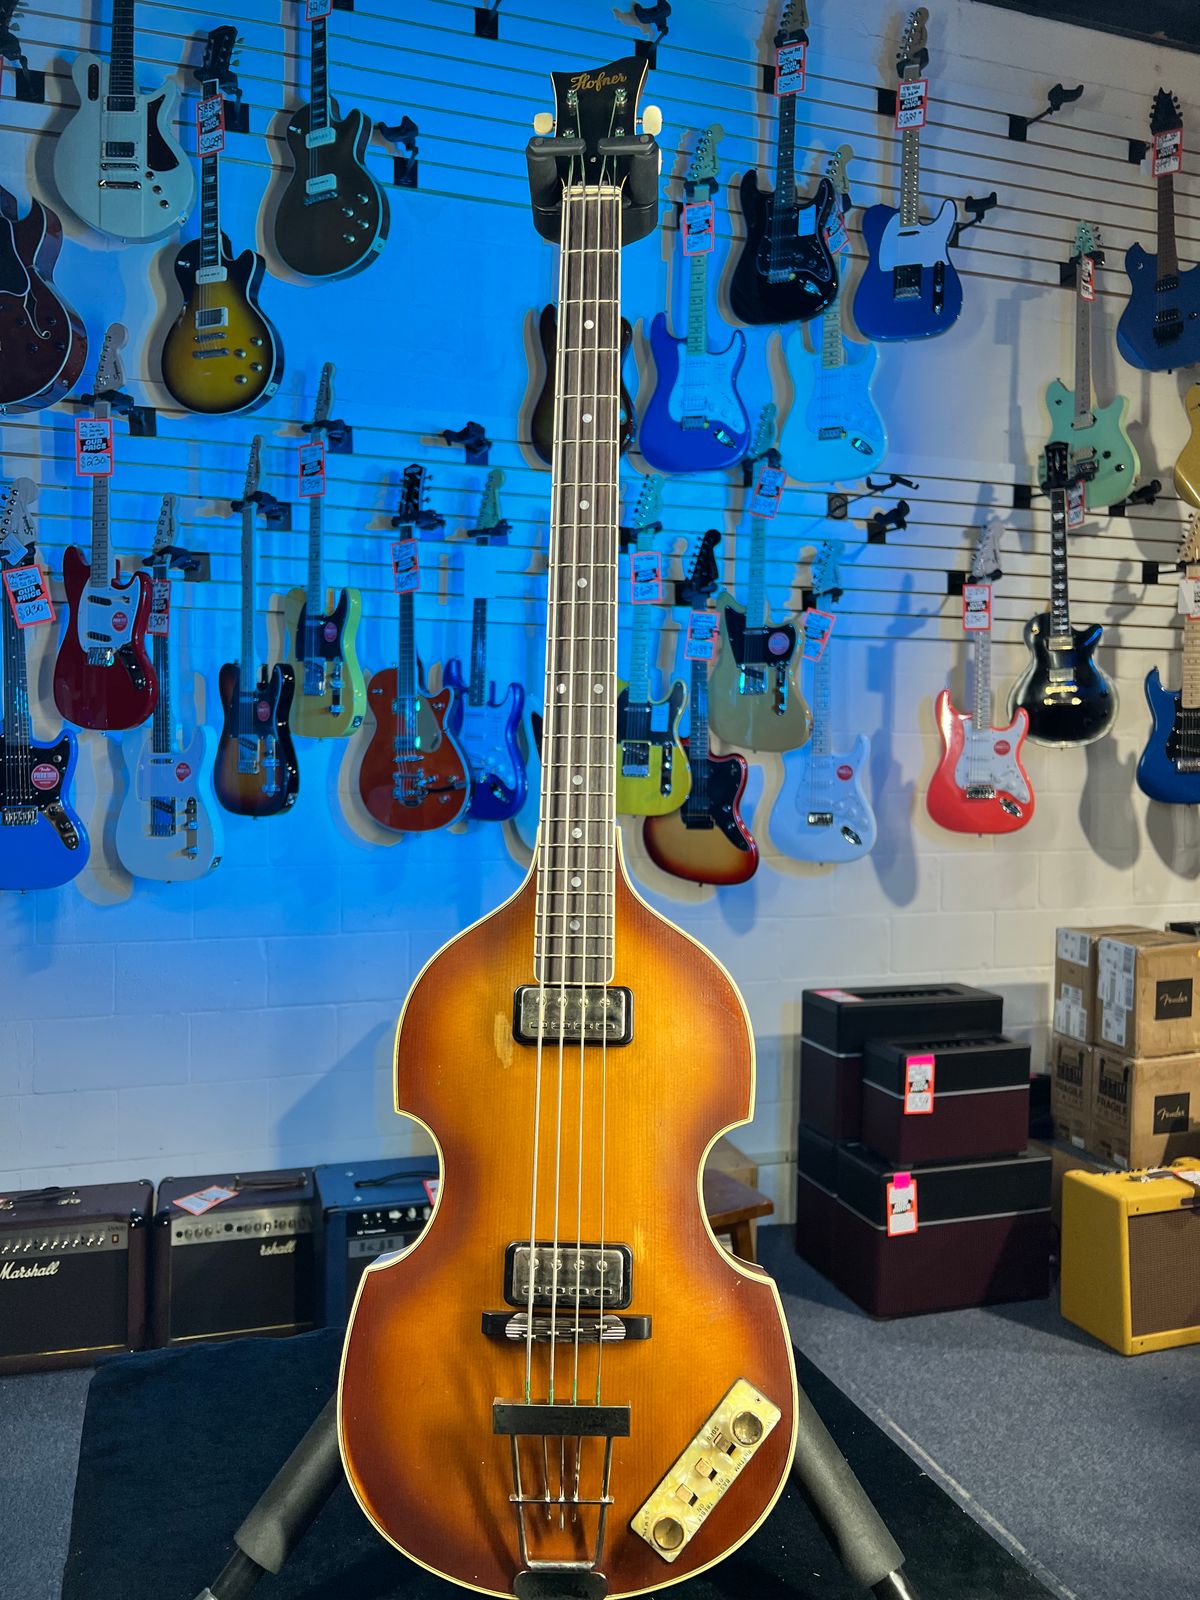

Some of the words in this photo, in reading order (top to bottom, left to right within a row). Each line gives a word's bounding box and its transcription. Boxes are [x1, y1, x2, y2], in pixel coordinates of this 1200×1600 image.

[82, 443, 107, 452] PRICE
[16, 588, 42, 603] PRICE
[18, 585, 36, 597] OUR
[1160, 991, 1188, 1007] Fender
[1096, 1095, 1129, 1116] FRAGILE
[1156, 1105, 1185, 1121] Fender
[0, 1260, 60, 1280] Marshall
